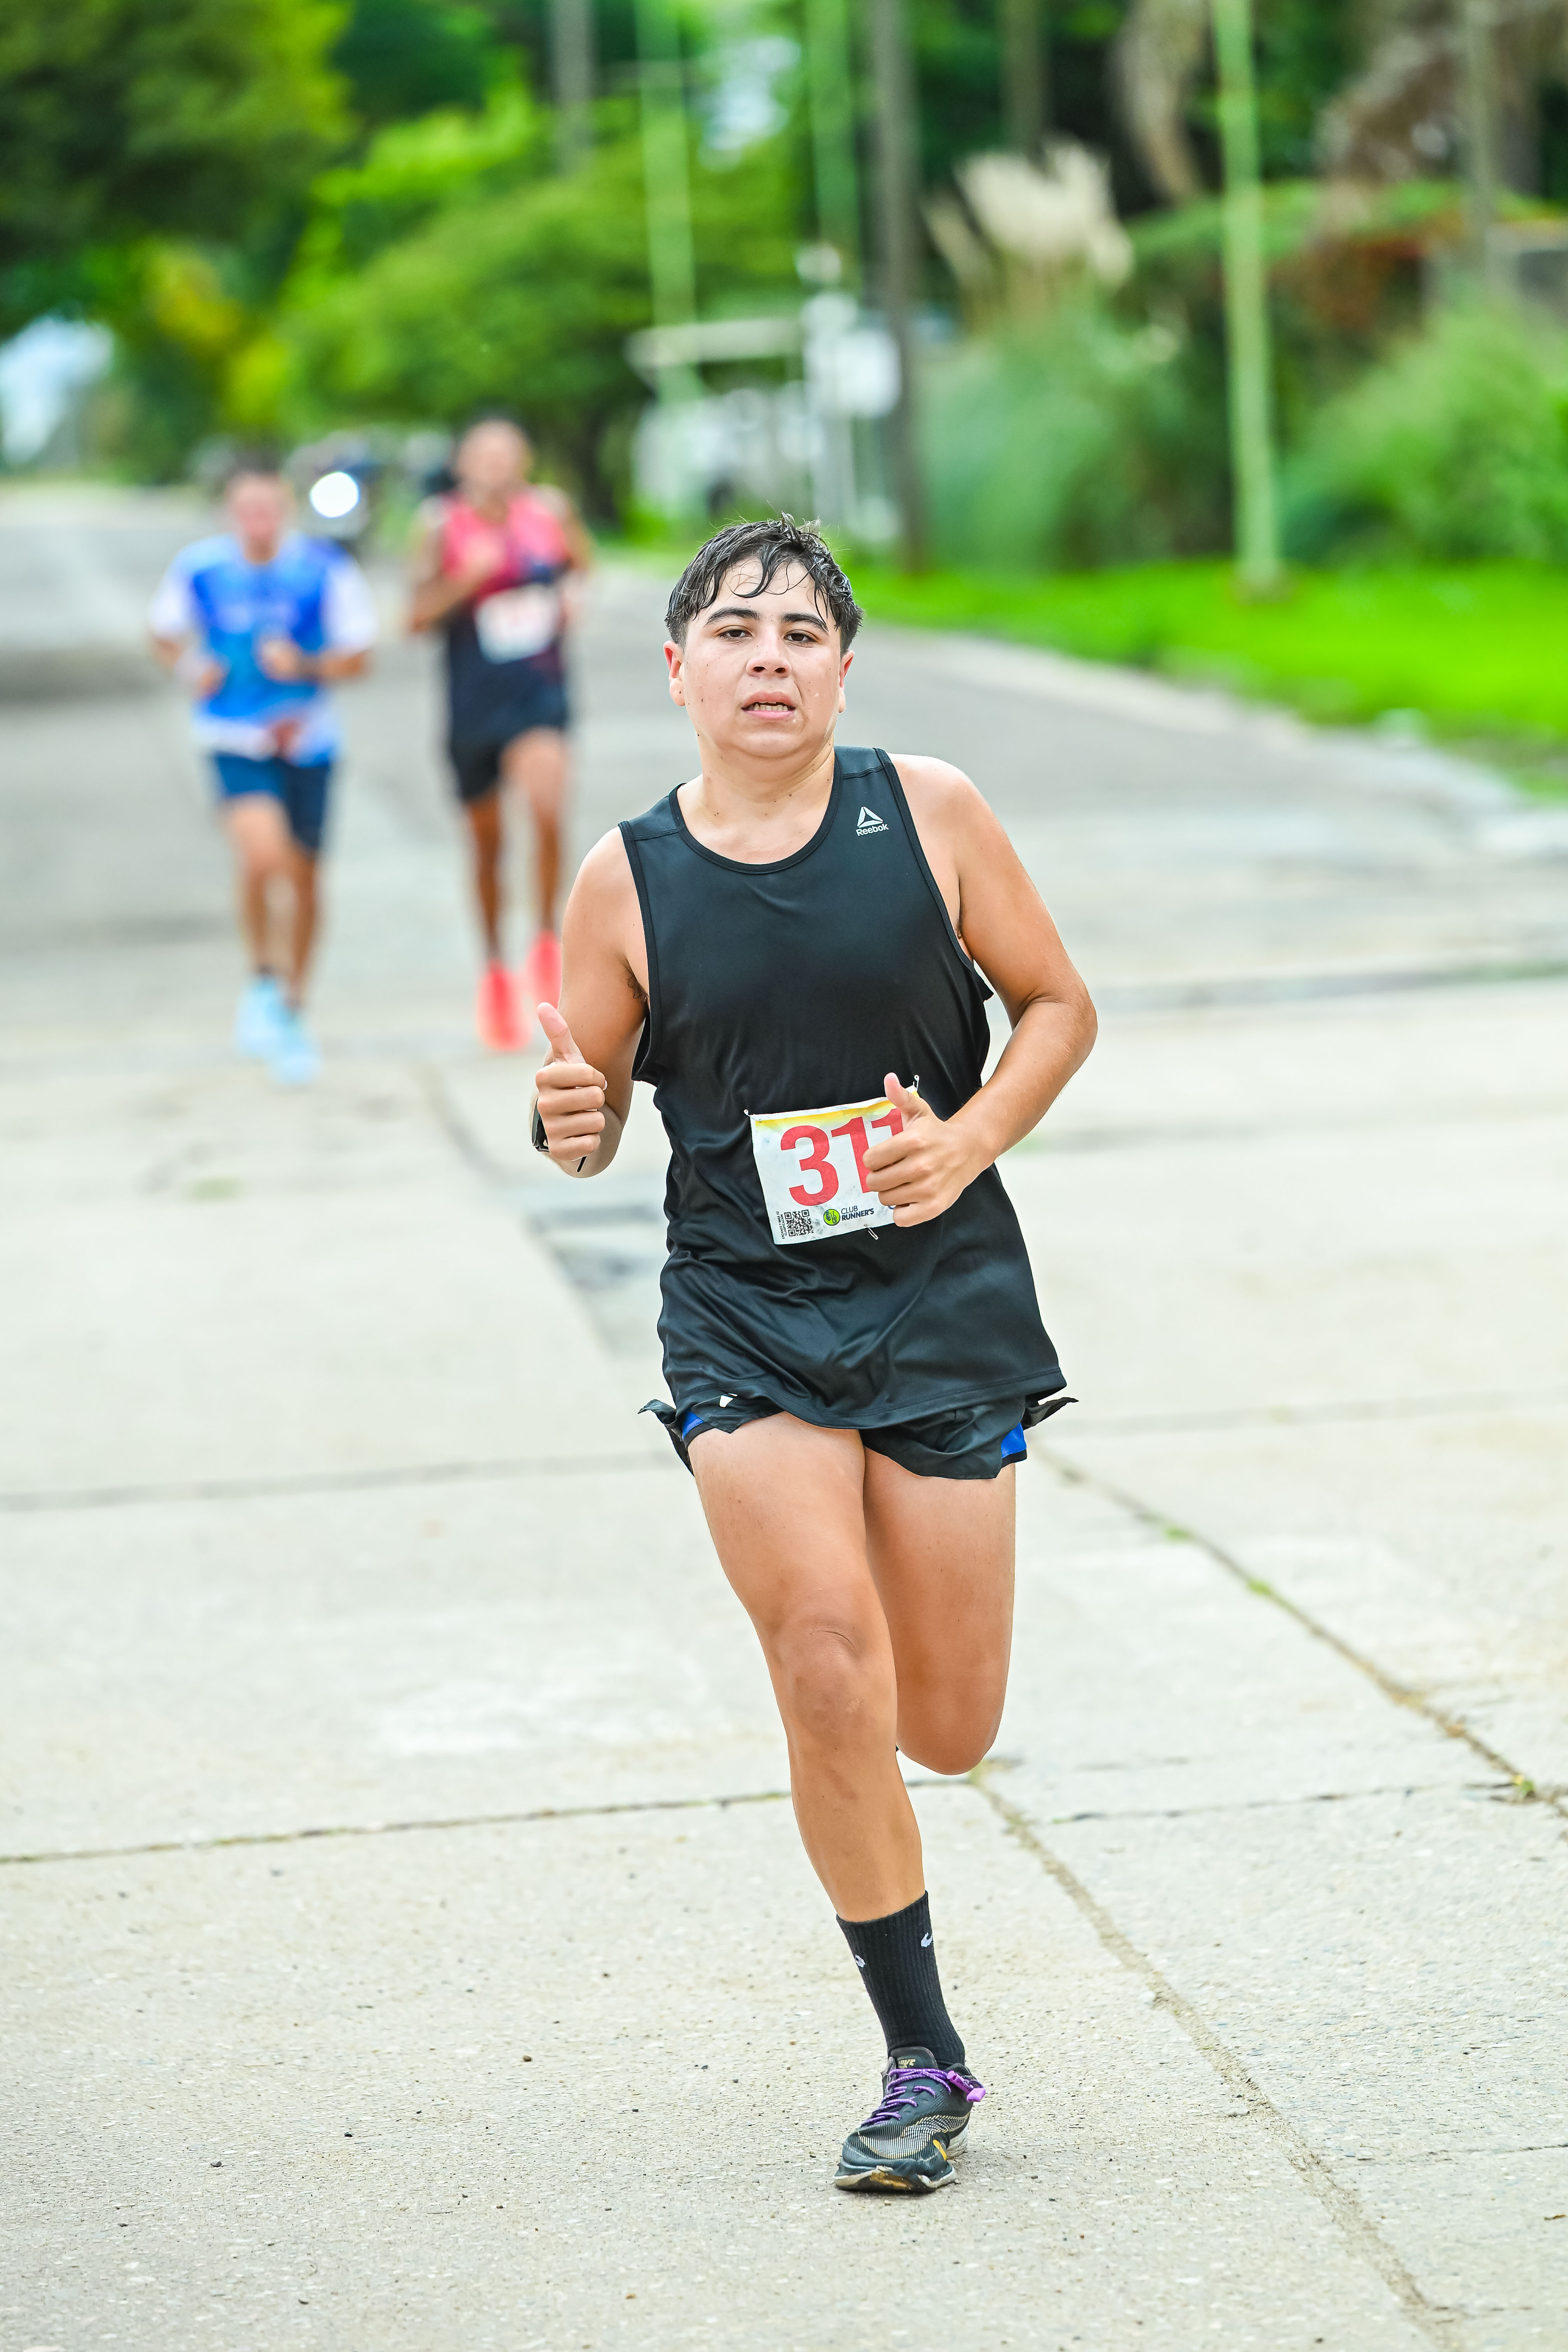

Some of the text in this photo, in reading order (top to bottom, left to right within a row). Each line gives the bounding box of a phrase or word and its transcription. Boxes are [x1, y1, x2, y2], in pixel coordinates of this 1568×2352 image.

[856, 823, 889, 836] Reebok
[841, 1205, 858, 1214] CLUB
[842, 1208, 874, 1221] RUNNER'S
